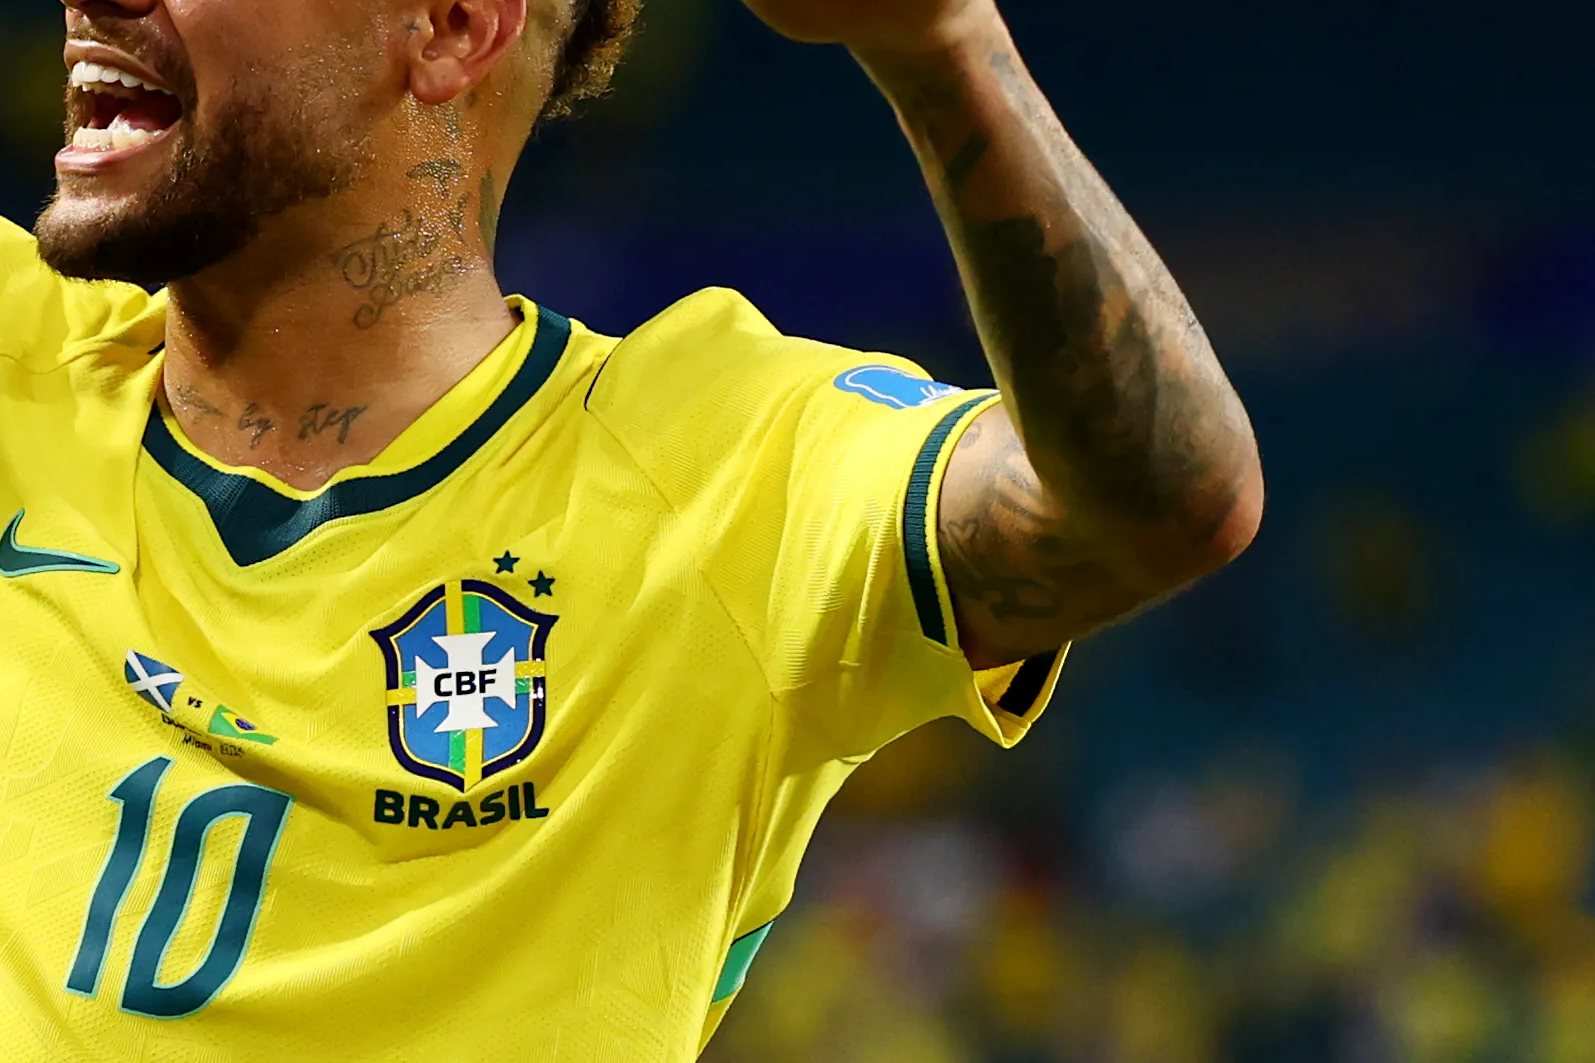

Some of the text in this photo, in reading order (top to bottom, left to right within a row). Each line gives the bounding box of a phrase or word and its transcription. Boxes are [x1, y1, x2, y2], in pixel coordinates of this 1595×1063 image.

[434, 669, 497, 697] CBF
[374, 782, 550, 830] BRASIL
[63, 755, 295, 1020] 10
